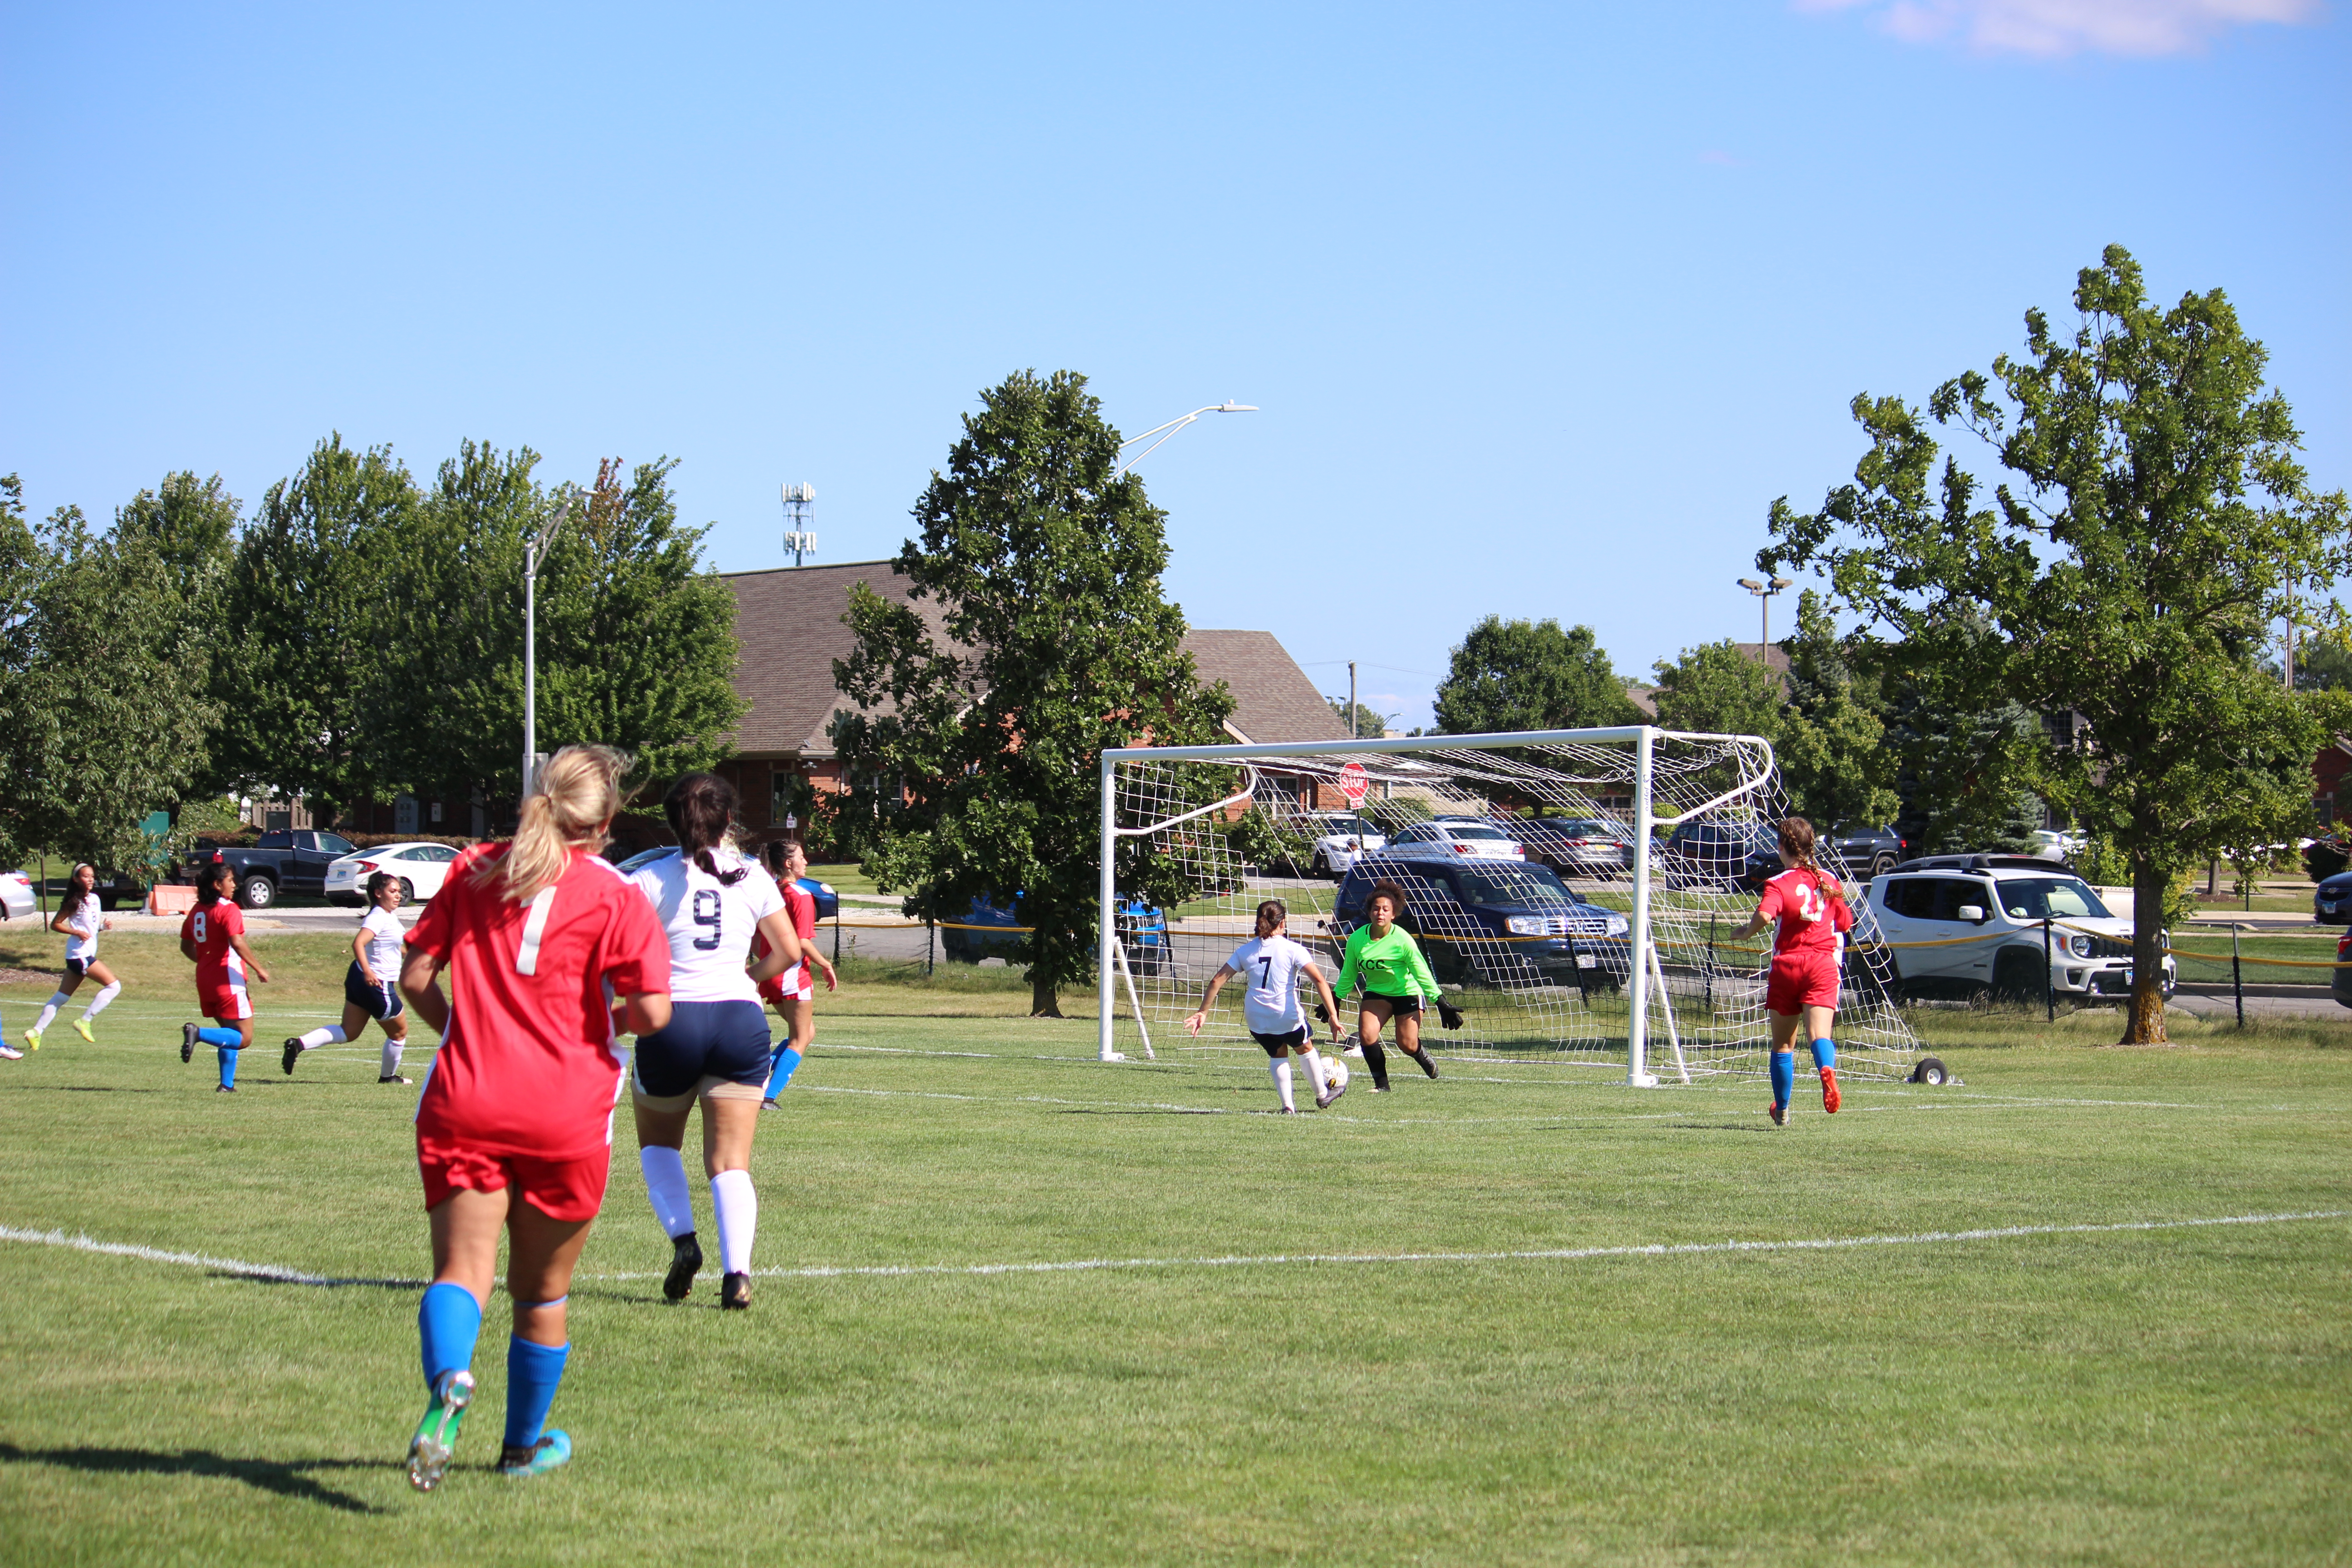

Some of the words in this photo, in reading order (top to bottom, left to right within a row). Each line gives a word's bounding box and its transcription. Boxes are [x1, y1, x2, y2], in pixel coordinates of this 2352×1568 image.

[1342, 774, 1366, 789] STOP
[194, 911, 206, 943] 8
[693, 889, 721, 950] 9
[1258, 956, 1272, 989] 7
[1358, 960, 1385, 970] KCC
